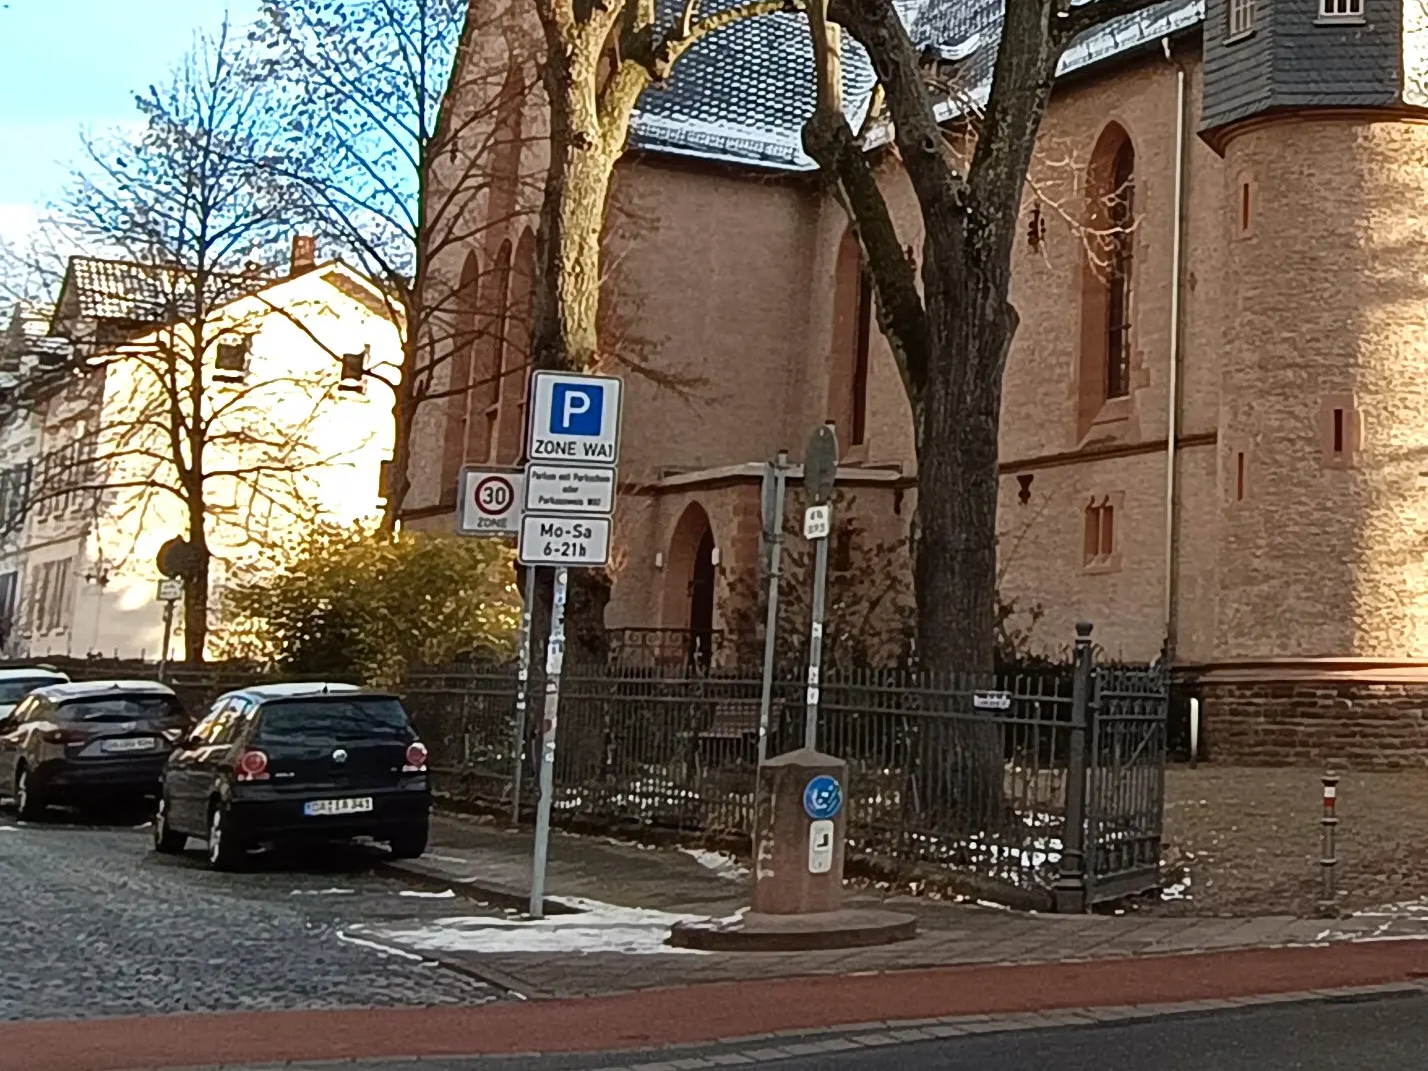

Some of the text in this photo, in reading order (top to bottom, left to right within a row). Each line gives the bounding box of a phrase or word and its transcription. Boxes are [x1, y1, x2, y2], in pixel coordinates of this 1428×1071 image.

[561, 390, 591, 428] P
[534, 439, 613, 458] ZONE WA1
[482, 486, 507, 506] 30
[540, 523, 592, 539] Mo-Sa
[543, 541, 587, 558] 6-21h
